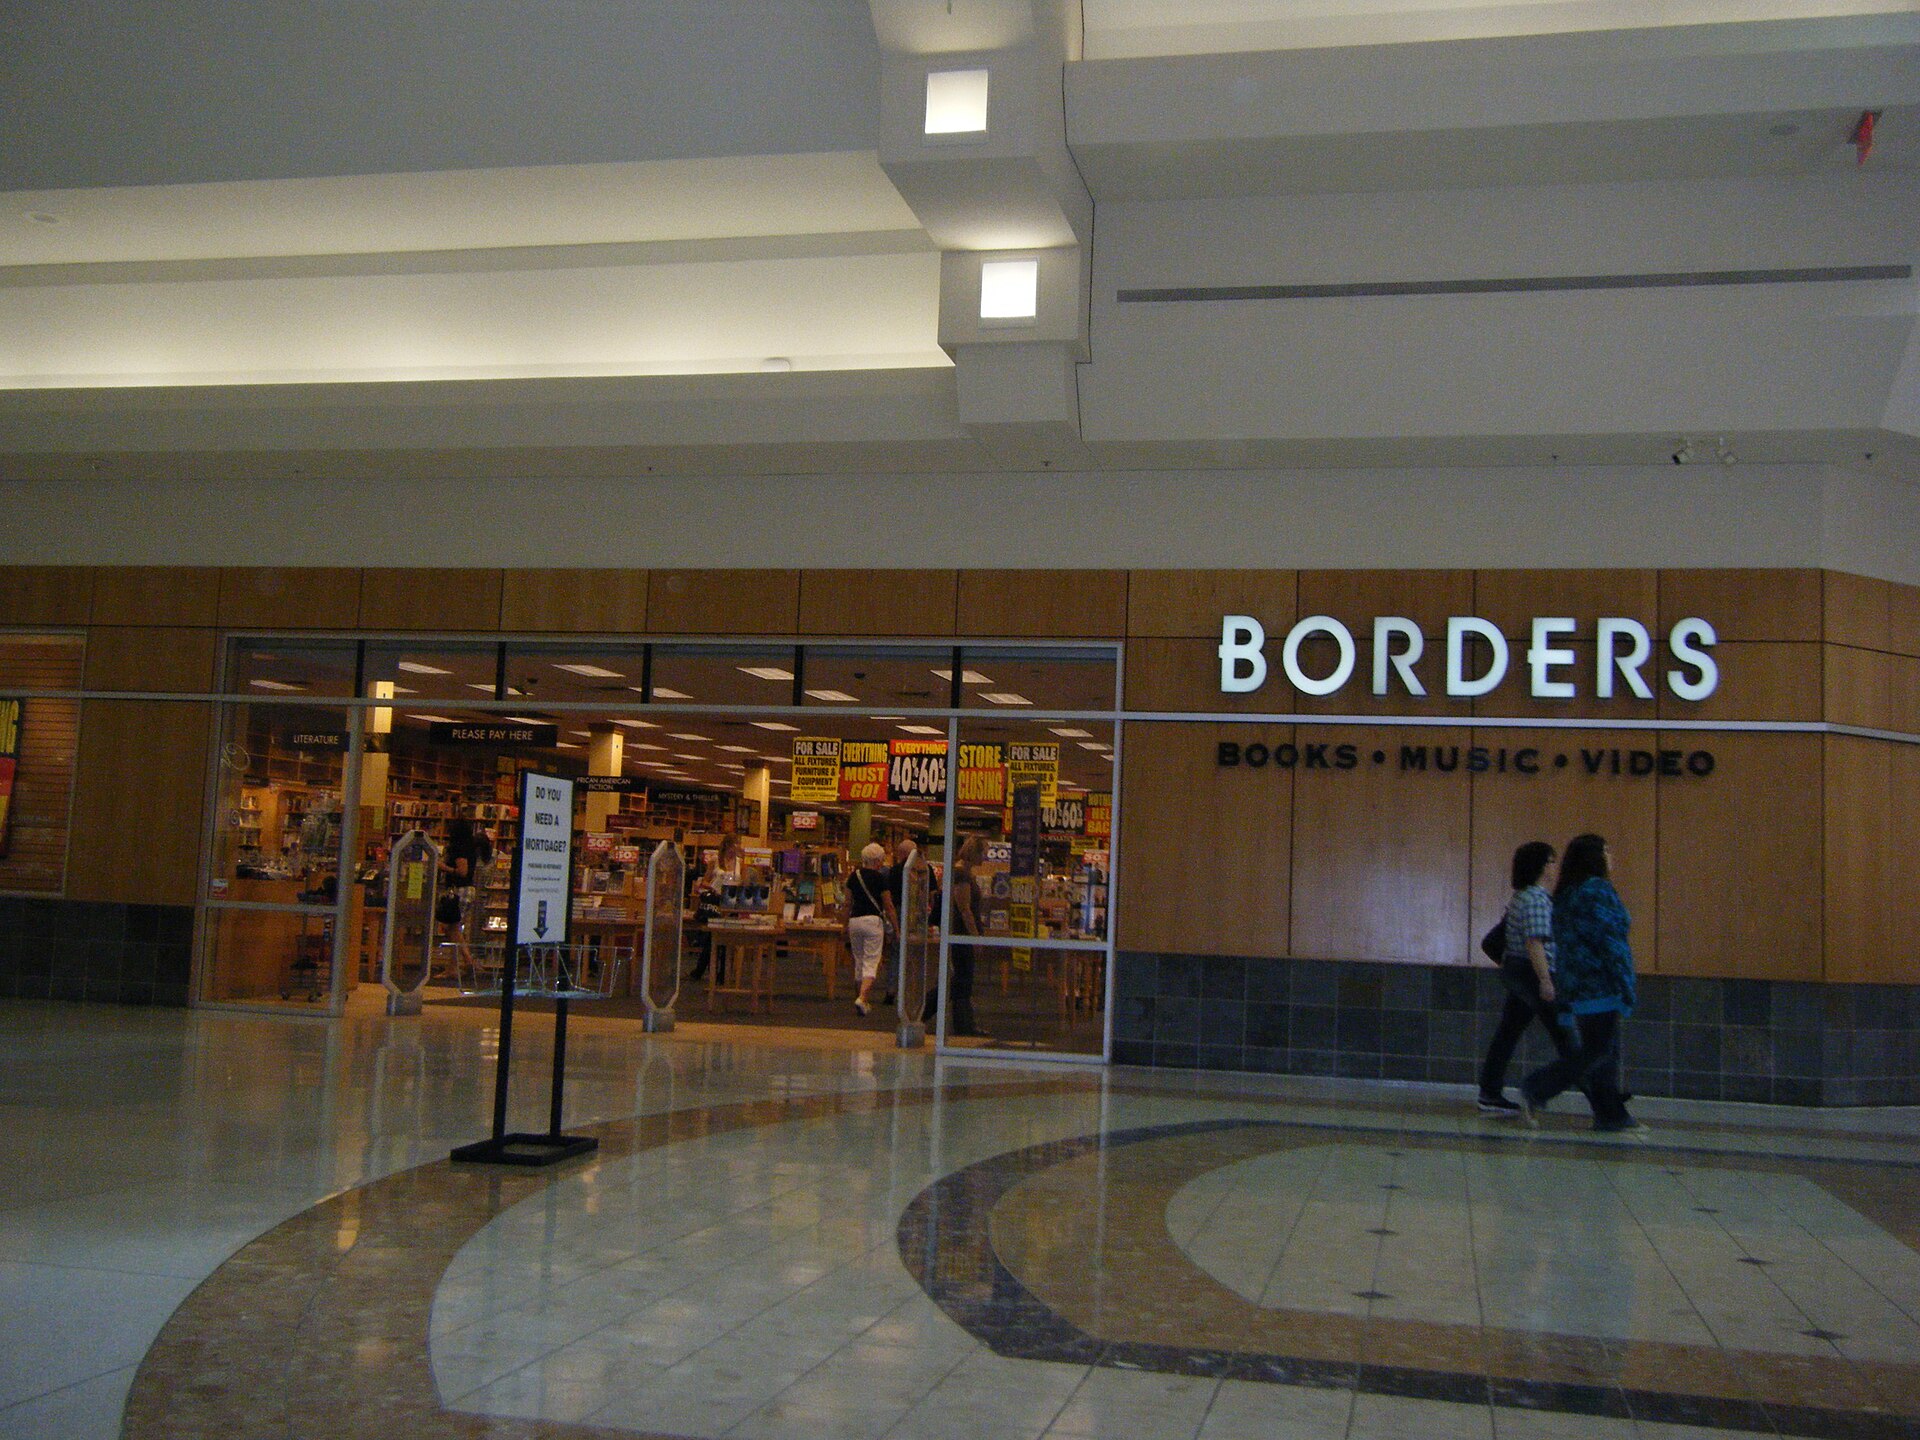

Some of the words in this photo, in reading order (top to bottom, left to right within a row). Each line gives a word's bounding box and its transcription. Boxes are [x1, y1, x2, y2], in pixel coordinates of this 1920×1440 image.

[1218, 614, 1721, 702] BORDERS
[293, 735, 339, 745] LITERATURE
[452, 728, 485, 740] PLEASE
[488, 729, 506, 740] PAY
[509, 730, 534, 741] HERE
[796, 742, 813, 755] FOR
[815, 742, 838, 756] SALE
[843, 742, 888, 763] EVERYTHING
[895, 743, 947, 755] EVERYTHING
[1011, 746, 1030, 760] FOR
[1032, 747, 1057, 761] SALE
[794, 757, 805, 765] ALL
[960, 744, 1001, 769] STORE
[1217, 742, 1359, 770] BOOKS
[1400, 745, 1541, 775] MUSIC
[1580, 748, 1717, 778] VIDEO
[795, 767, 829, 776] FURNITURE
[844, 766, 886, 783] MUST
[576, 777, 601, 785] FRICAN
[797, 777, 833, 786] EQUIPMENT
[958, 770, 1001, 801] CLOSING
[536, 786, 546, 799] DO
[547, 788, 561, 801] YOU
[850, 783, 880, 799] GO!
[535, 813, 553, 825] NEED
[554, 815, 559, 826] A
[525, 838, 567, 852] MORTGAGE?
